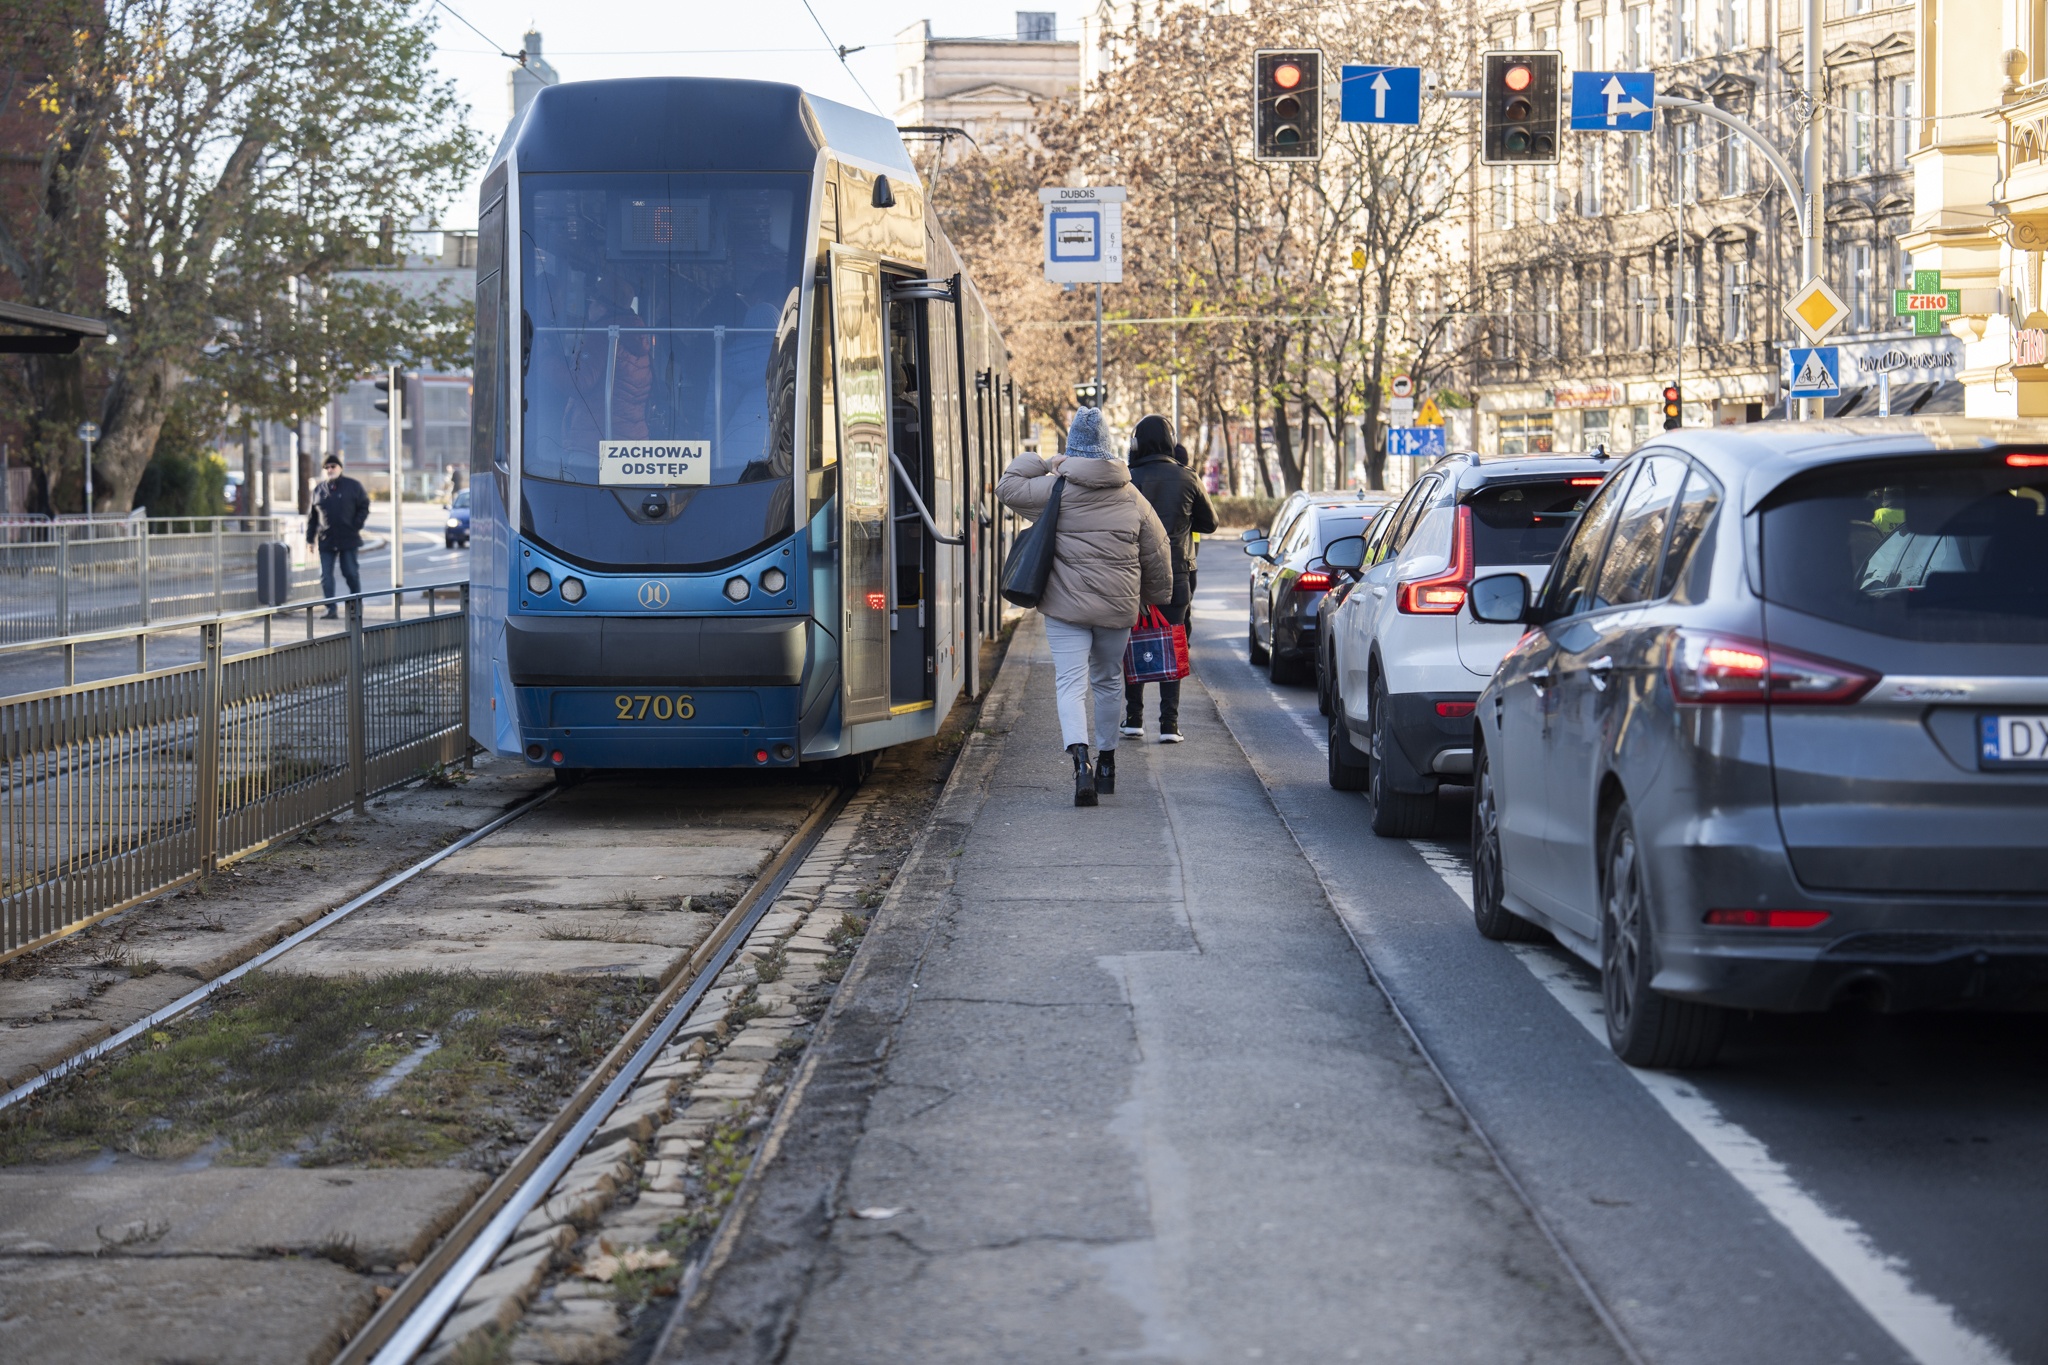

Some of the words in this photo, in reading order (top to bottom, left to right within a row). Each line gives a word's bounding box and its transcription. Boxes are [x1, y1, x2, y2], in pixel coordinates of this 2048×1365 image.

[1060, 189, 1095, 199] DUBOIS
[654, 206, 673, 243] 6
[608, 446, 702, 459] ZACHOWAJ
[622, 463, 689, 478] ODSTĘP
[615, 694, 695, 720] 2706
[1983, 743, 1999, 756] PL
